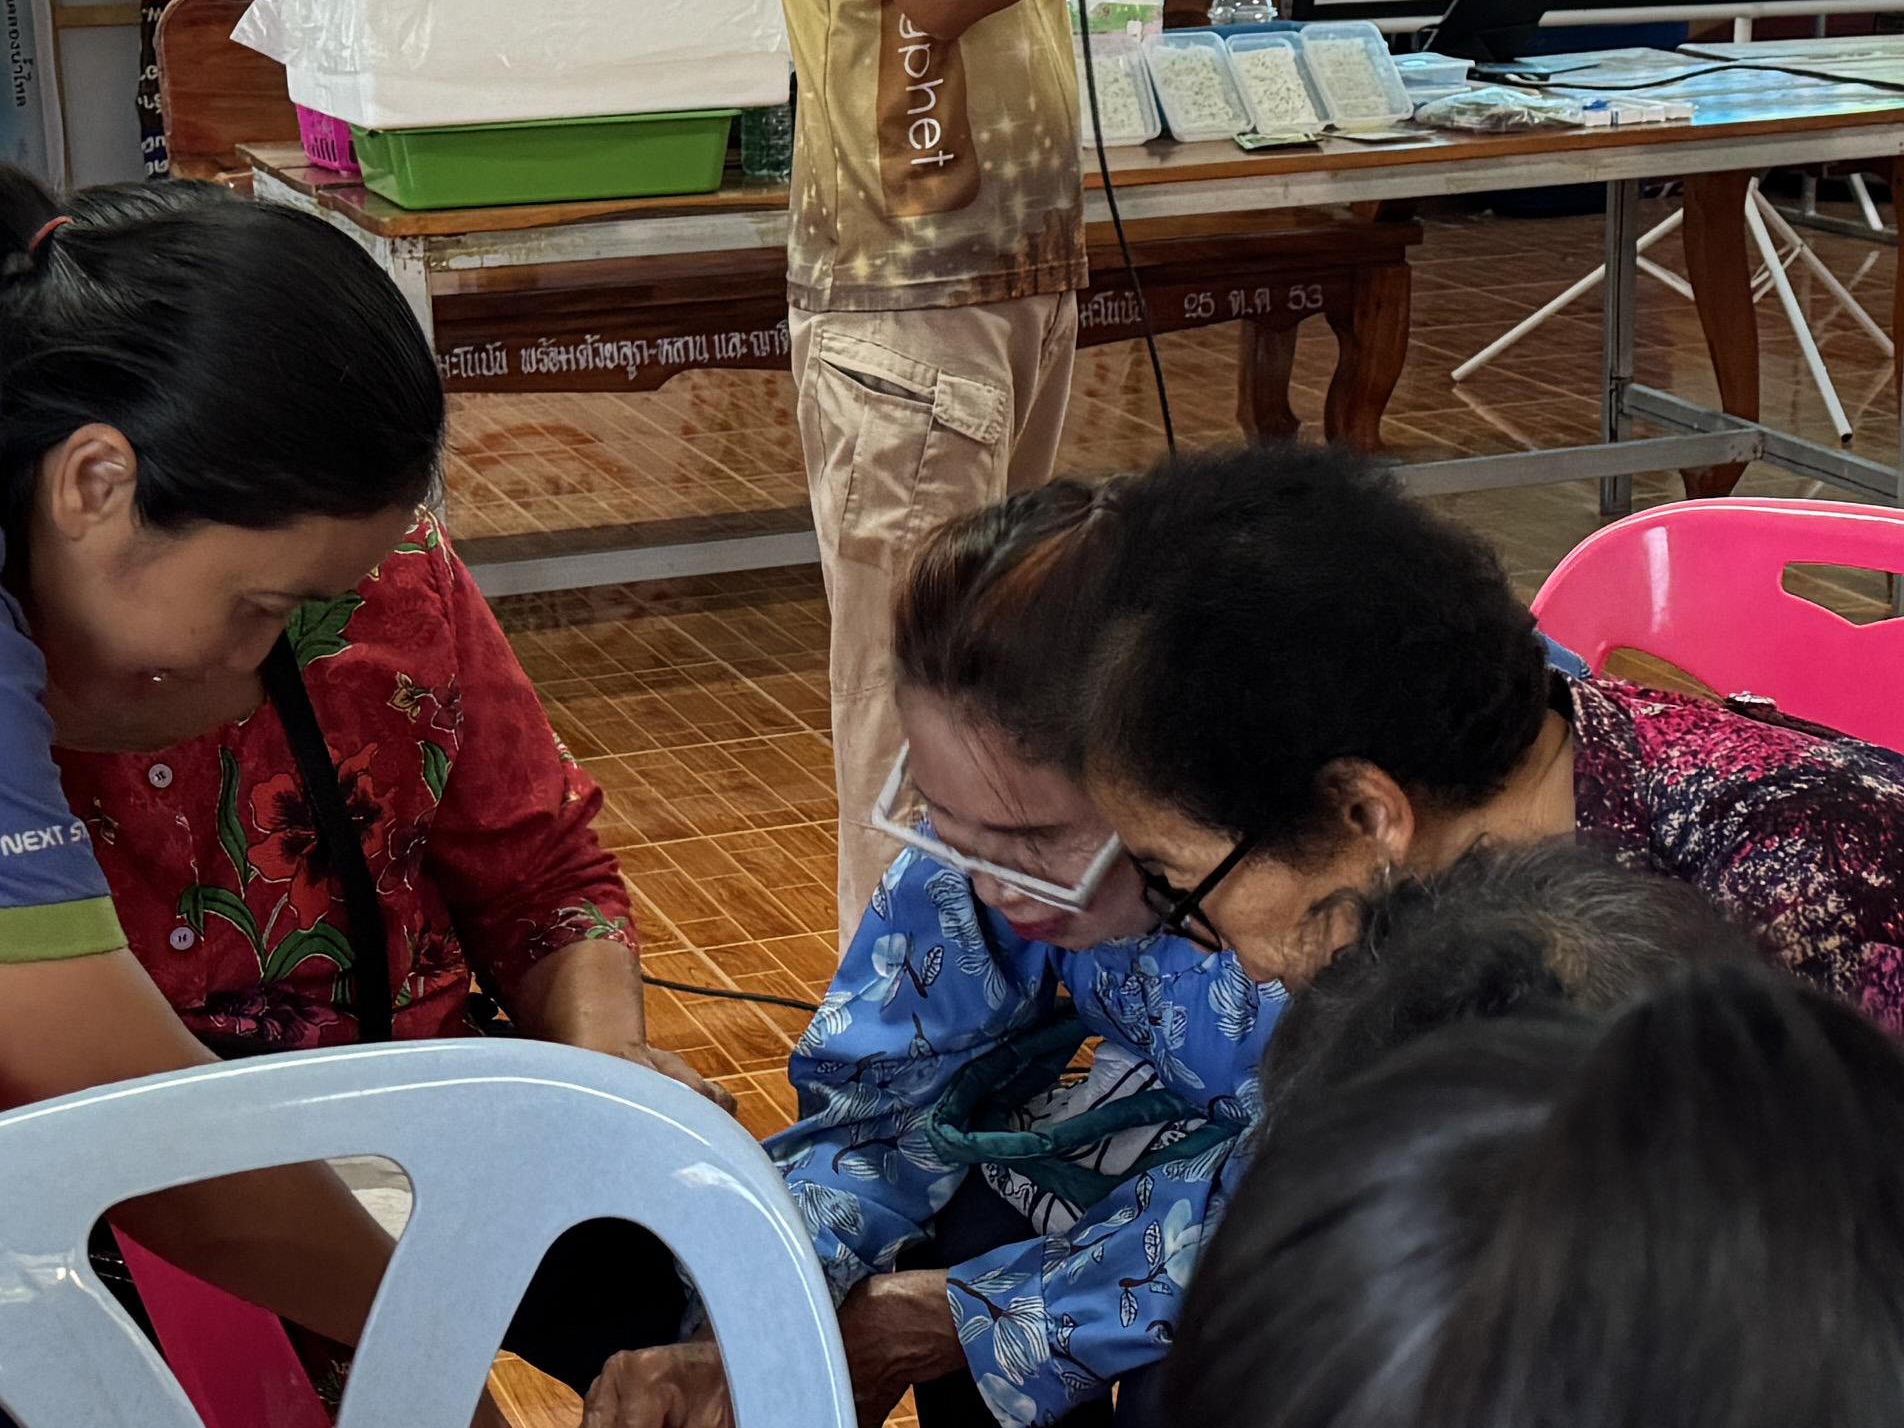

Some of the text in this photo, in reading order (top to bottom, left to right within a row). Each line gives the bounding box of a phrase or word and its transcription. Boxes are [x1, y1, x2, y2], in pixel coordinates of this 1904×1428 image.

[1183, 292, 1216, 319] 25
[1287, 284, 1325, 311] 53
[0, 825, 65, 857] NEXT
